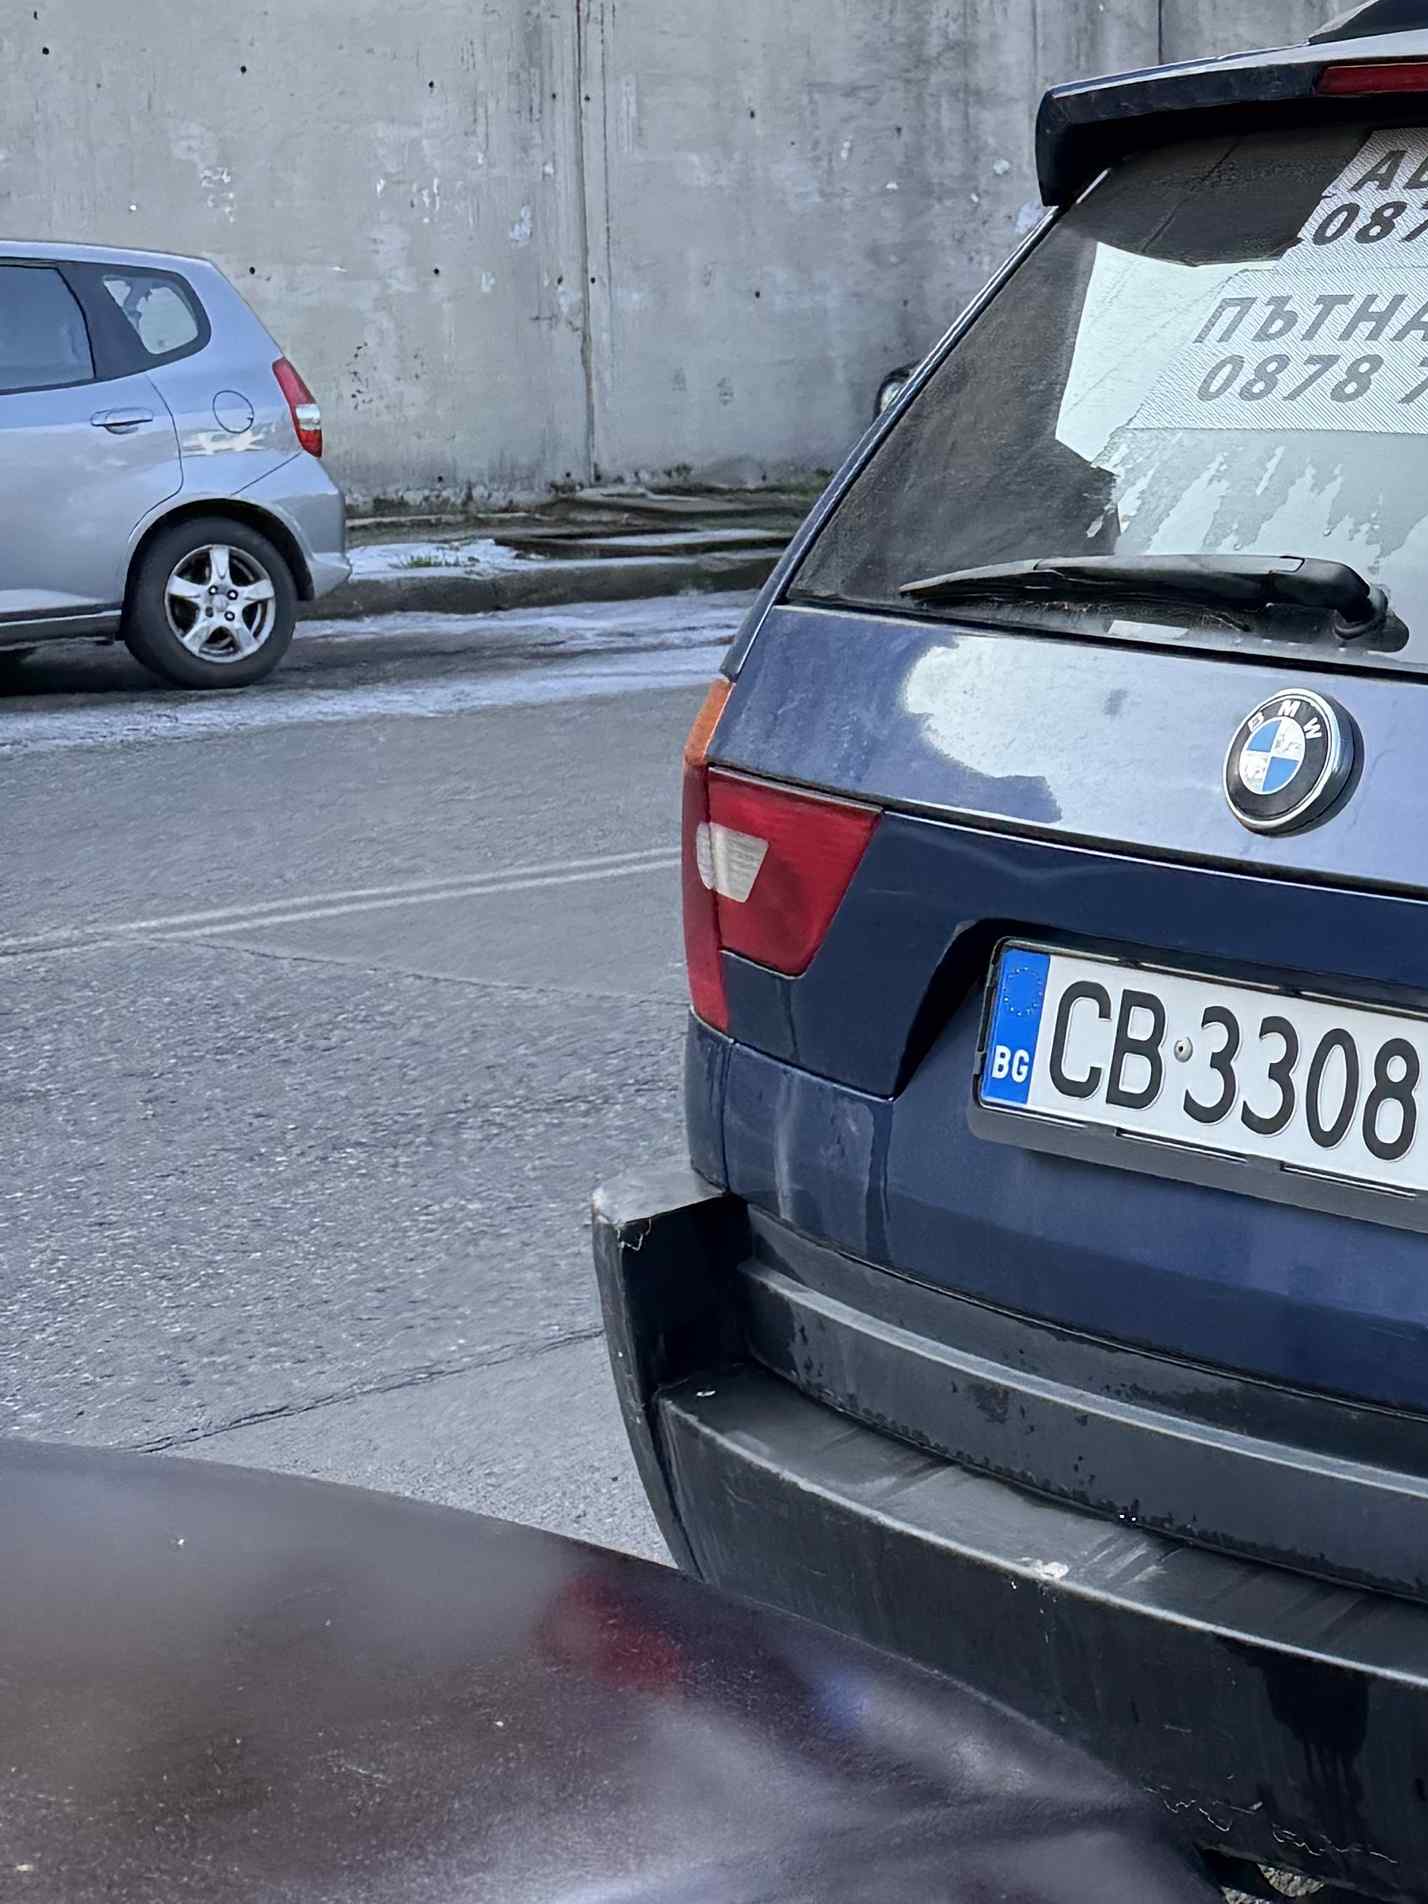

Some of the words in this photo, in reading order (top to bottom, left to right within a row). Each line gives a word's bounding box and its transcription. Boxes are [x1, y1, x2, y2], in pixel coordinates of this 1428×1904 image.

[1197, 353, 1383, 404] 0878
[1247, 700, 1324, 741] BMW
[991, 1043, 1031, 1085] BG
